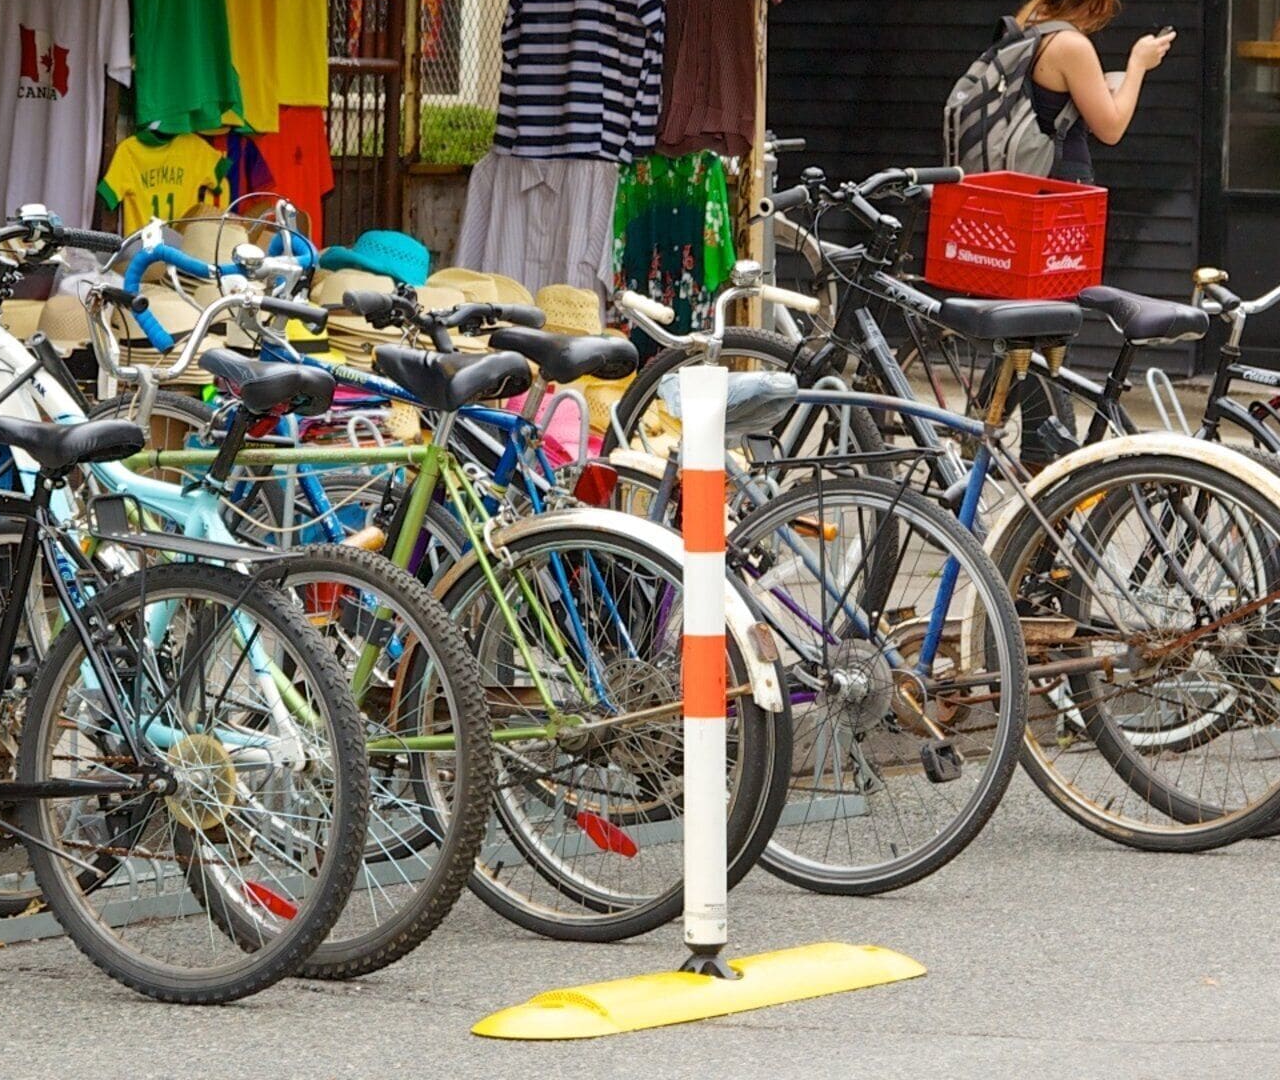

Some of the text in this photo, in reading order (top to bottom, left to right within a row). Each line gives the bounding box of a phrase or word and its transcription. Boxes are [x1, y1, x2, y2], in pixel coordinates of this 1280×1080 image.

[141, 165, 185, 189] NEYMAR
[152, 192, 175, 228] 11
[957, 248, 1012, 270] Silverwood
